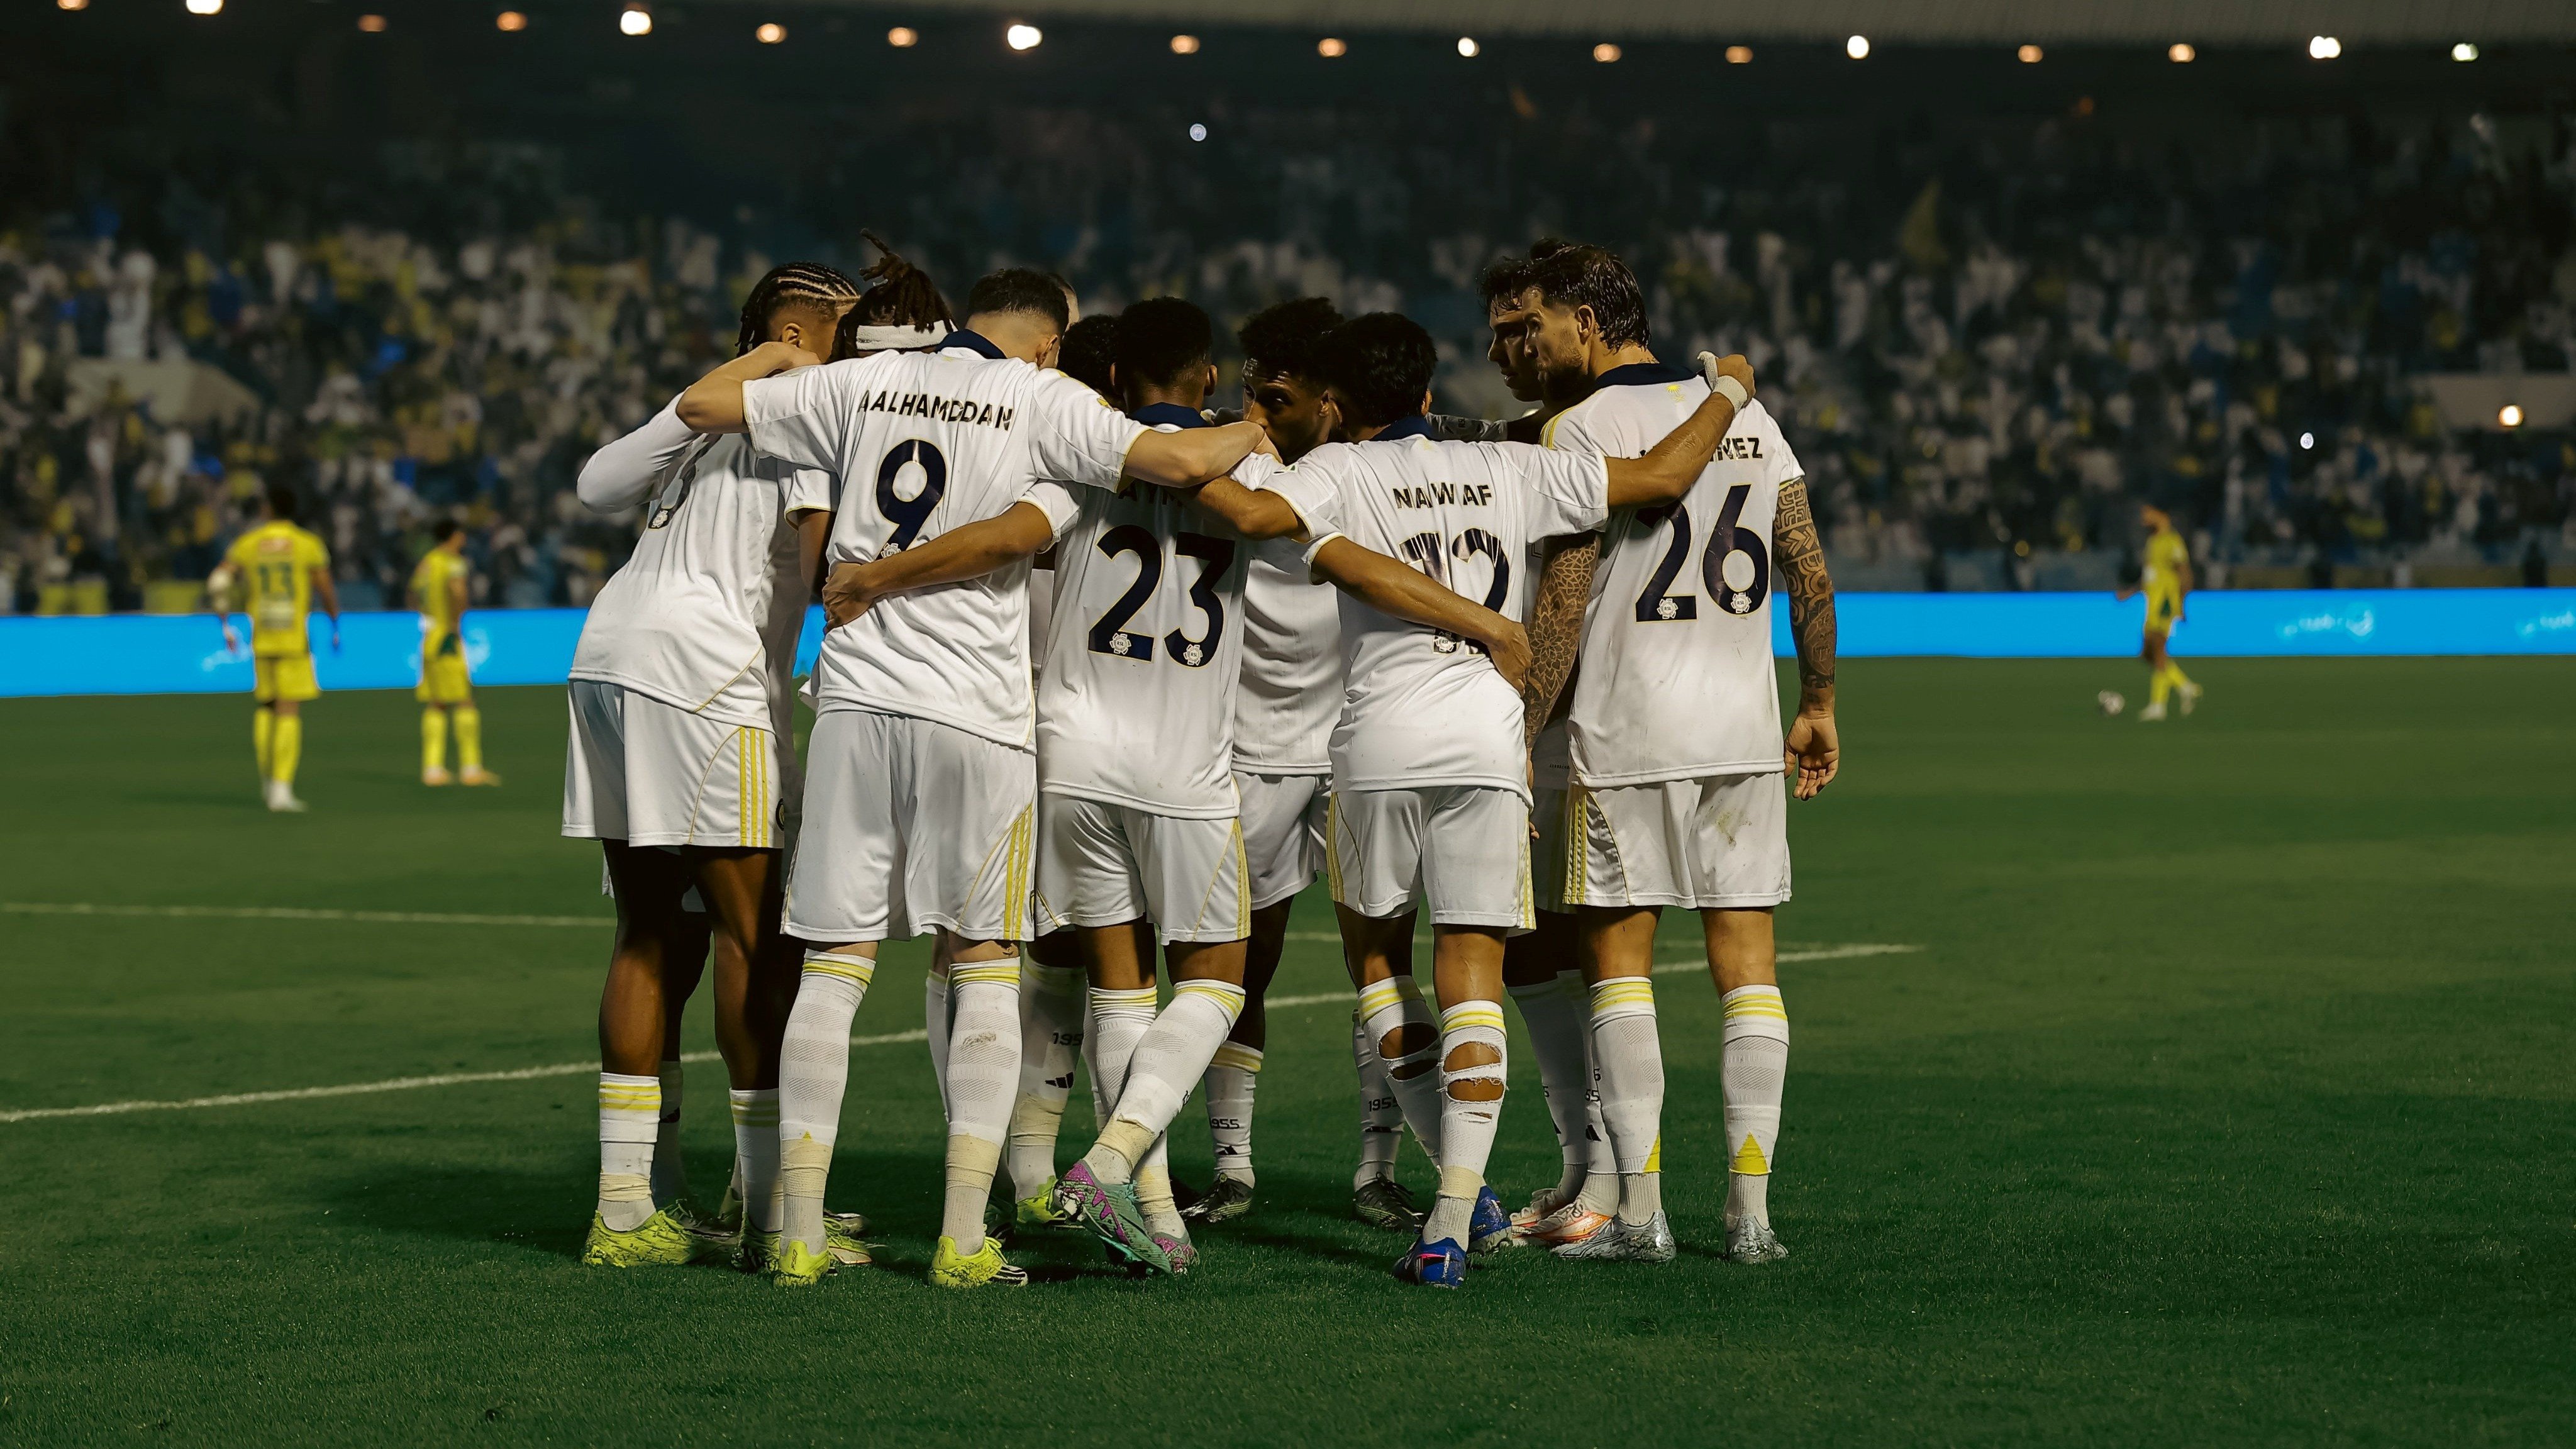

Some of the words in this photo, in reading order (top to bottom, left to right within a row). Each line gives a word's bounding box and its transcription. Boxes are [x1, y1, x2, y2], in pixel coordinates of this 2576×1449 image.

[875, 438, 947, 560] 9
[1392, 482, 1493, 509] NAWAF
[1635, 484, 1769, 623] 26
[1087, 523, 1236, 669] 23
